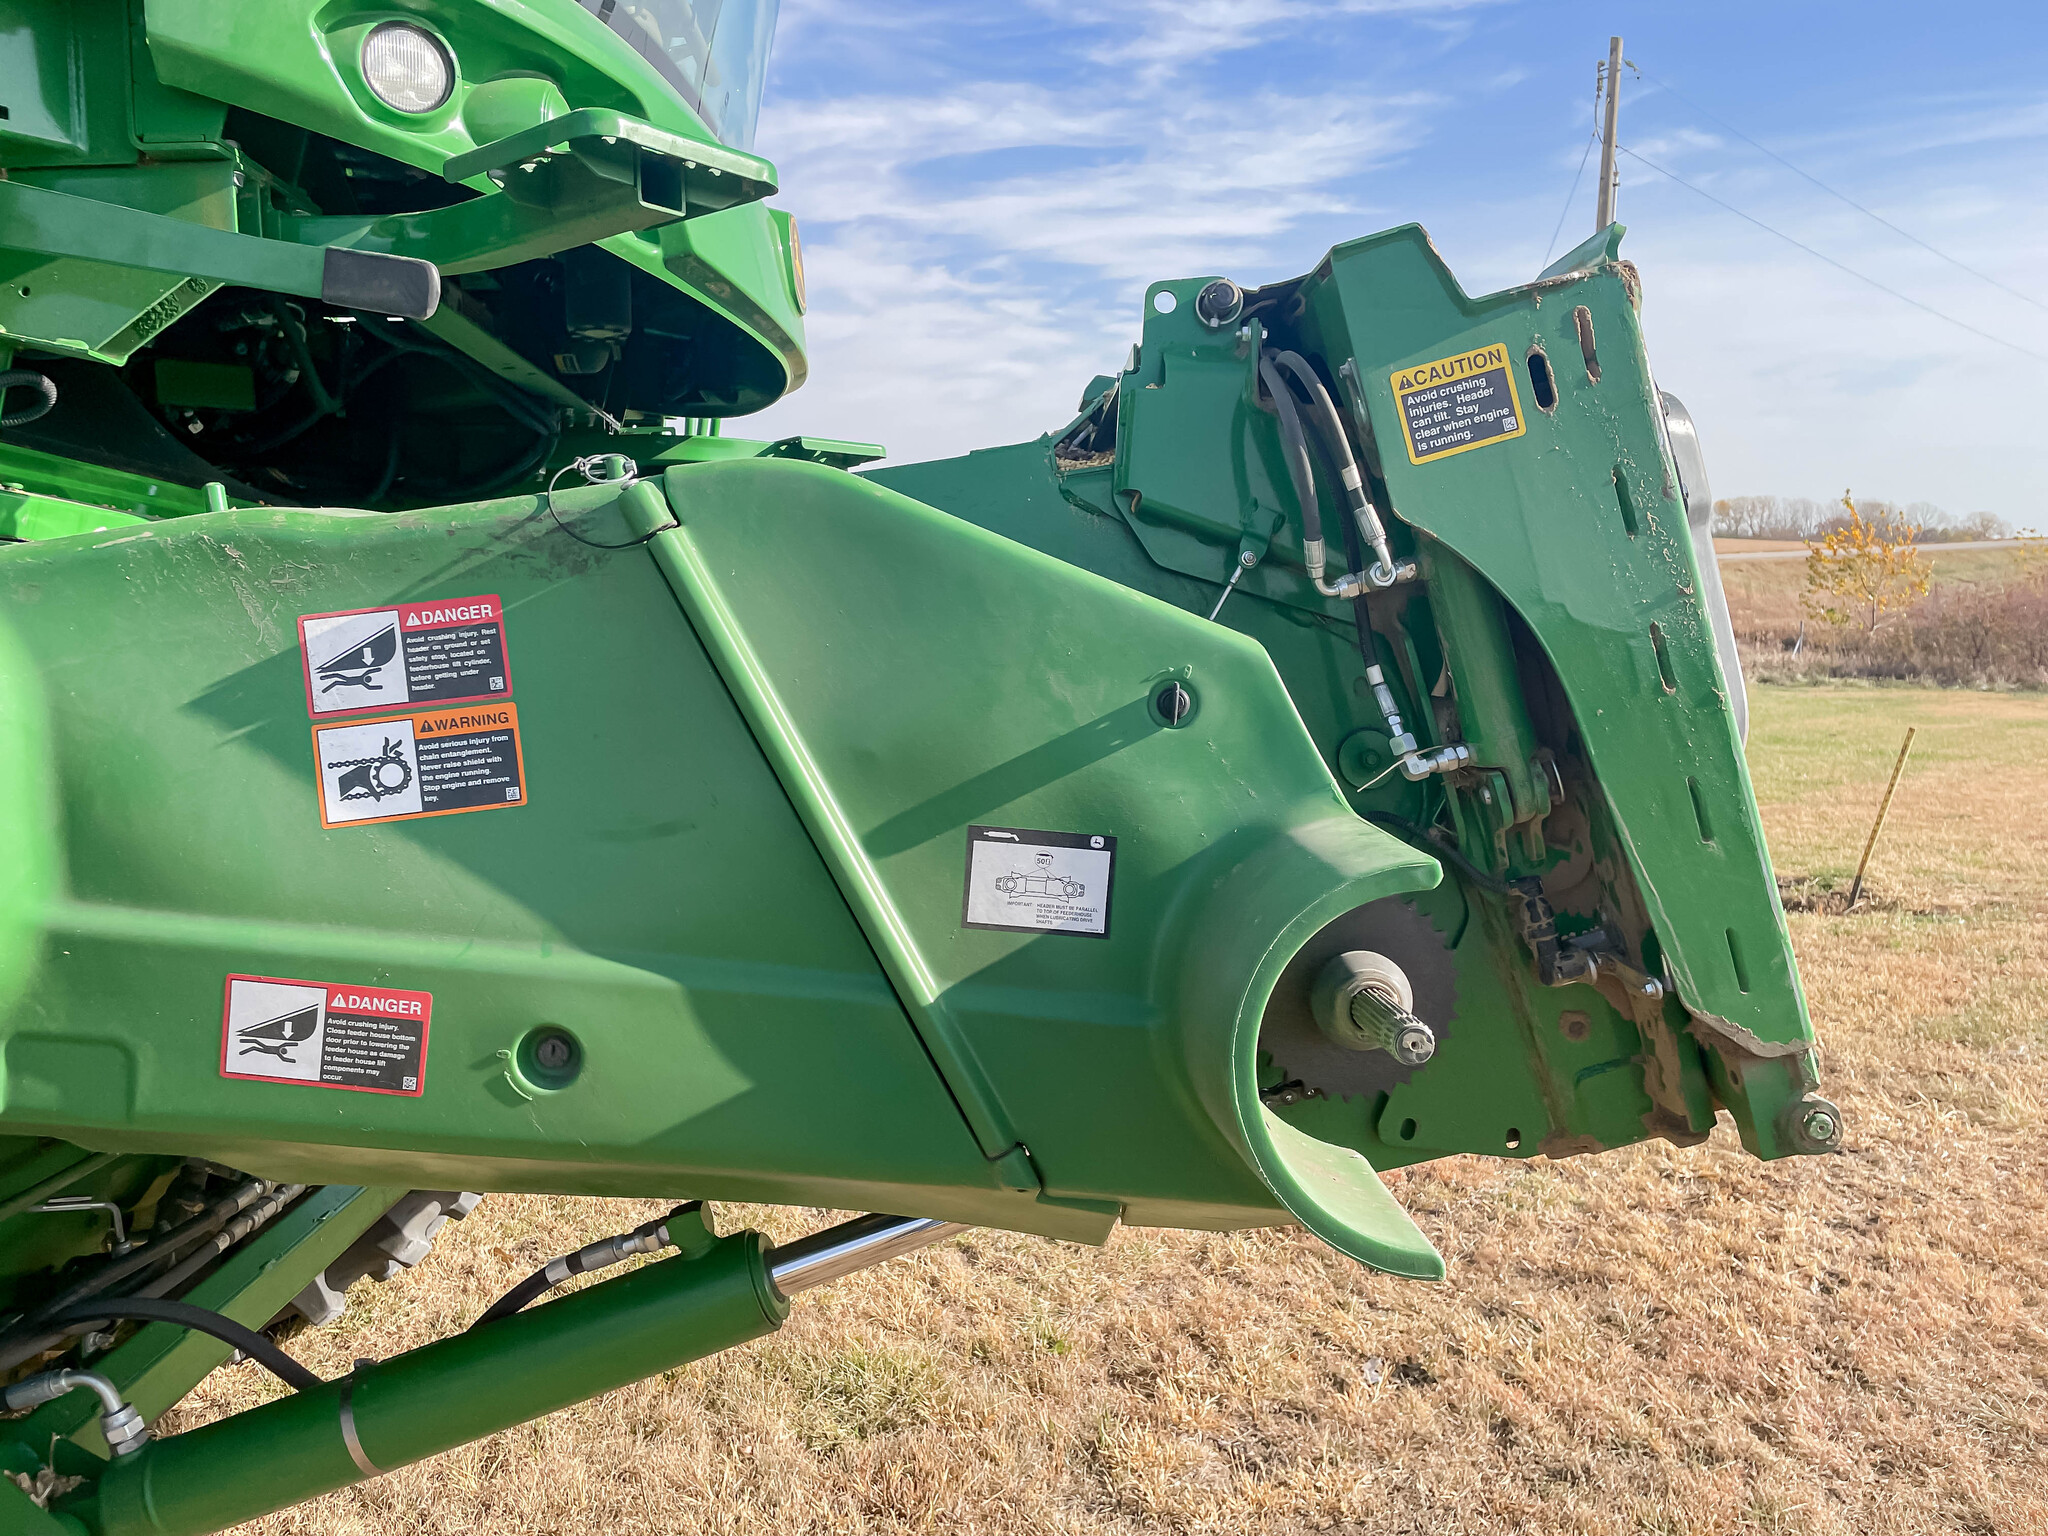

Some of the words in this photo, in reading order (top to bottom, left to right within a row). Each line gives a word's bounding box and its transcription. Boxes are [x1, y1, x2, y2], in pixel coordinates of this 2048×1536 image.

[1413, 349, 1502, 385] CAUTION
[1407, 390, 1438, 406] Avoid
[1440, 378, 1487, 397] crushing
[1409, 400, 1452, 417] injuries.
[1456, 387, 1494, 404] Header
[1412, 416, 1432, 428] can
[1433, 412, 1451, 423] tilt.
[1456, 403, 1479, 416] Stay
[1414, 426, 1440, 439] clear
[1443, 418, 1471, 432] when
[1474, 407, 1510, 423] engine
[1417, 440, 1427, 451] is
[1430, 430, 1474, 448] running.
[421, 604, 493, 625] DANGER
[428, 633, 456, 641] crushing
[444, 642, 467, 650] ground
[431, 653, 447, 661] stop,
[464, 658, 491, 667] cylinder,
[435, 671, 457, 680] getting
[435, 712, 509, 730] WARNING
[419, 743, 439, 751] Avoid
[441, 739, 468, 748] serious
[469, 738, 490, 746] injury
[441, 748, 492, 759] entanglement.
[420, 763, 441, 771] Never
[463, 758, 485, 766] shield
[435, 771, 459, 780] engine
[461, 769, 491, 777] running.
[442, 781, 466, 789] engine
[349, 996, 421, 1014] DANGER
[348, 1021, 377, 1029] crushing
[325, 1046, 346, 1054] feeder
[379, 1051, 405, 1059] damage
[369, 1042, 397, 1050] lowering
[324, 1065, 364, 1074] components
